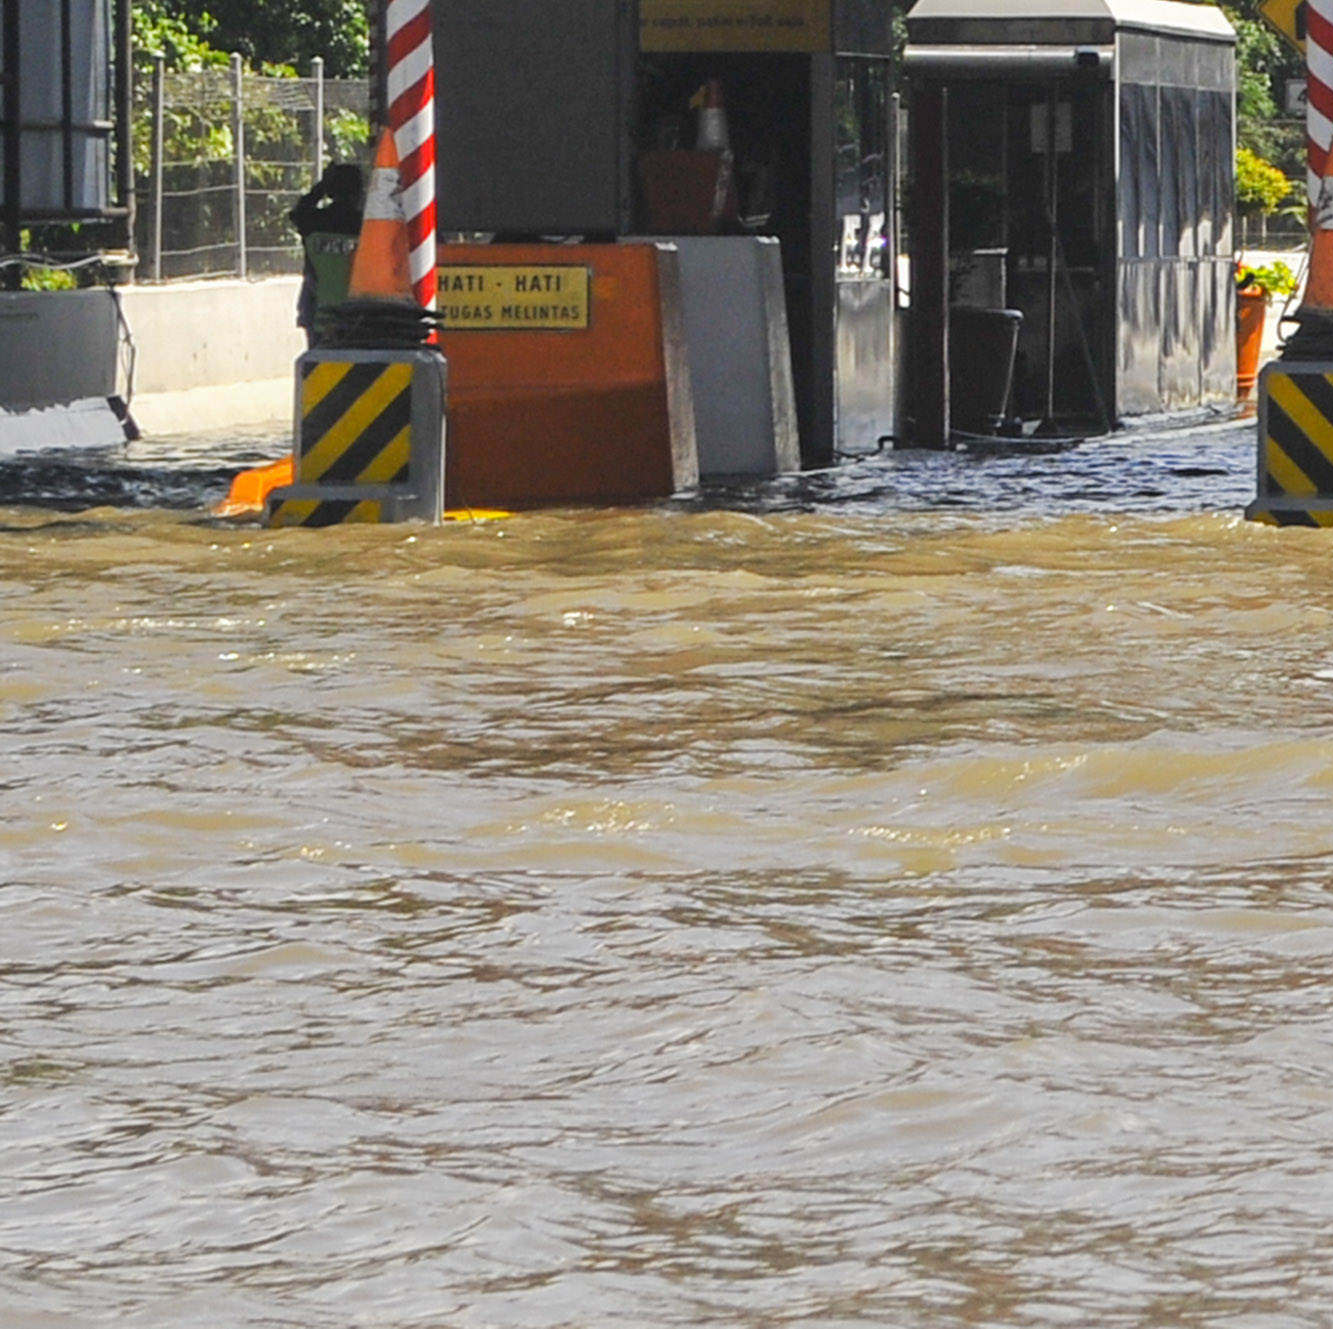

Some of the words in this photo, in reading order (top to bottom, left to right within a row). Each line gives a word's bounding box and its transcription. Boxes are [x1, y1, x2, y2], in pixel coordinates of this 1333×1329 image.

[438, 275, 484, 292] HATI
[514, 274, 562, 292] HATI
[501, 304, 580, 321] MELINTAS
